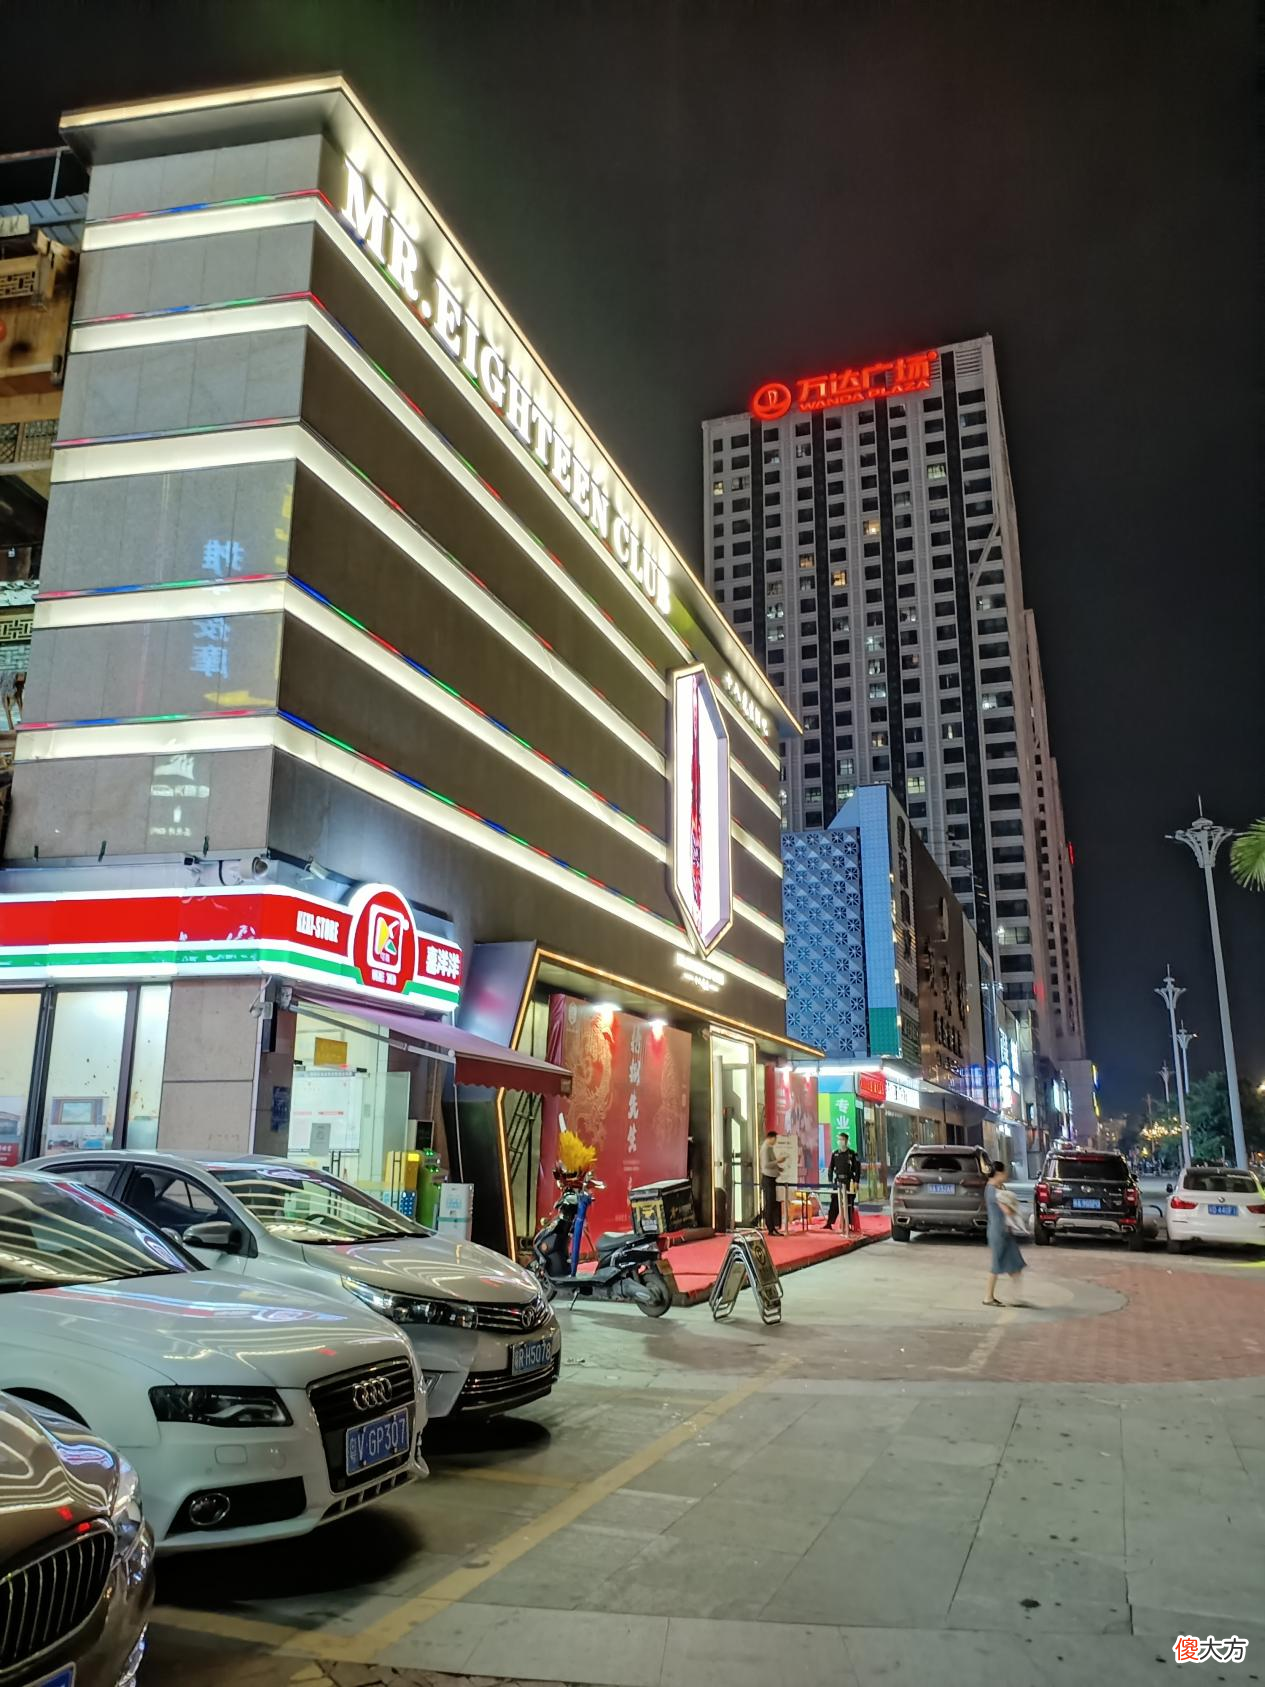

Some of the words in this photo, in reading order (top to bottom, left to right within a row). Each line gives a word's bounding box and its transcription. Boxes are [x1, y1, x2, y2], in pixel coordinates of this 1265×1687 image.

[342, 159, 432, 319] MR.
[433, 277, 610, 542] EIGHTEEN
[797, 353, 932, 402] 万达广场
[800, 392, 865, 411] WANDA
[868, 379, 931, 399] PLAZA
[425, 945, 461, 980] 喜洋洋
